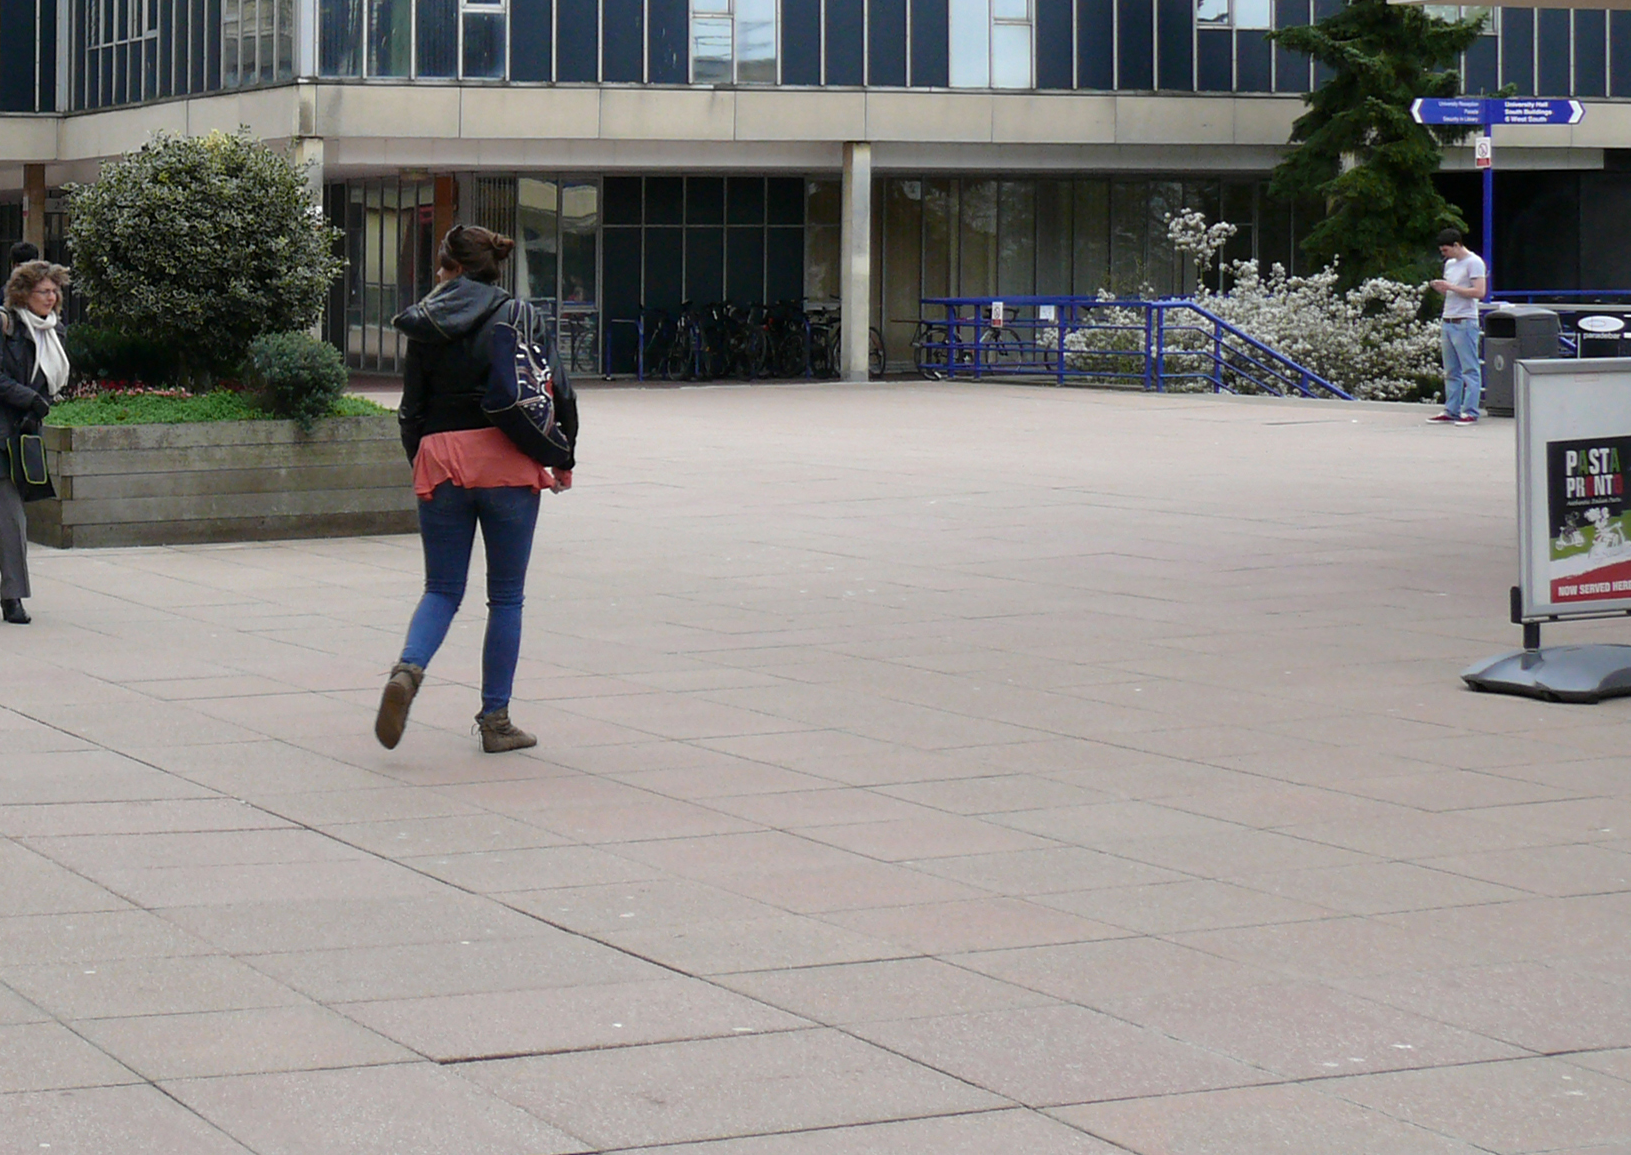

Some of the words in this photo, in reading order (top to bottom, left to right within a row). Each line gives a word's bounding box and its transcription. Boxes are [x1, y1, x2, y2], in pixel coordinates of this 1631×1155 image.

[1504, 101, 1535, 109] University
[1524, 108, 1553, 116] Buildings
[1583, 332, 1621, 340] paradebar
[1566, 447, 1621, 476] PASTA
[1566, 473, 1624, 498] PRONTO
[1558, 585, 1578, 597] NOW
[1579, 582, 1611, 594] SERVED
[1612, 580, 1631, 592] HERE
